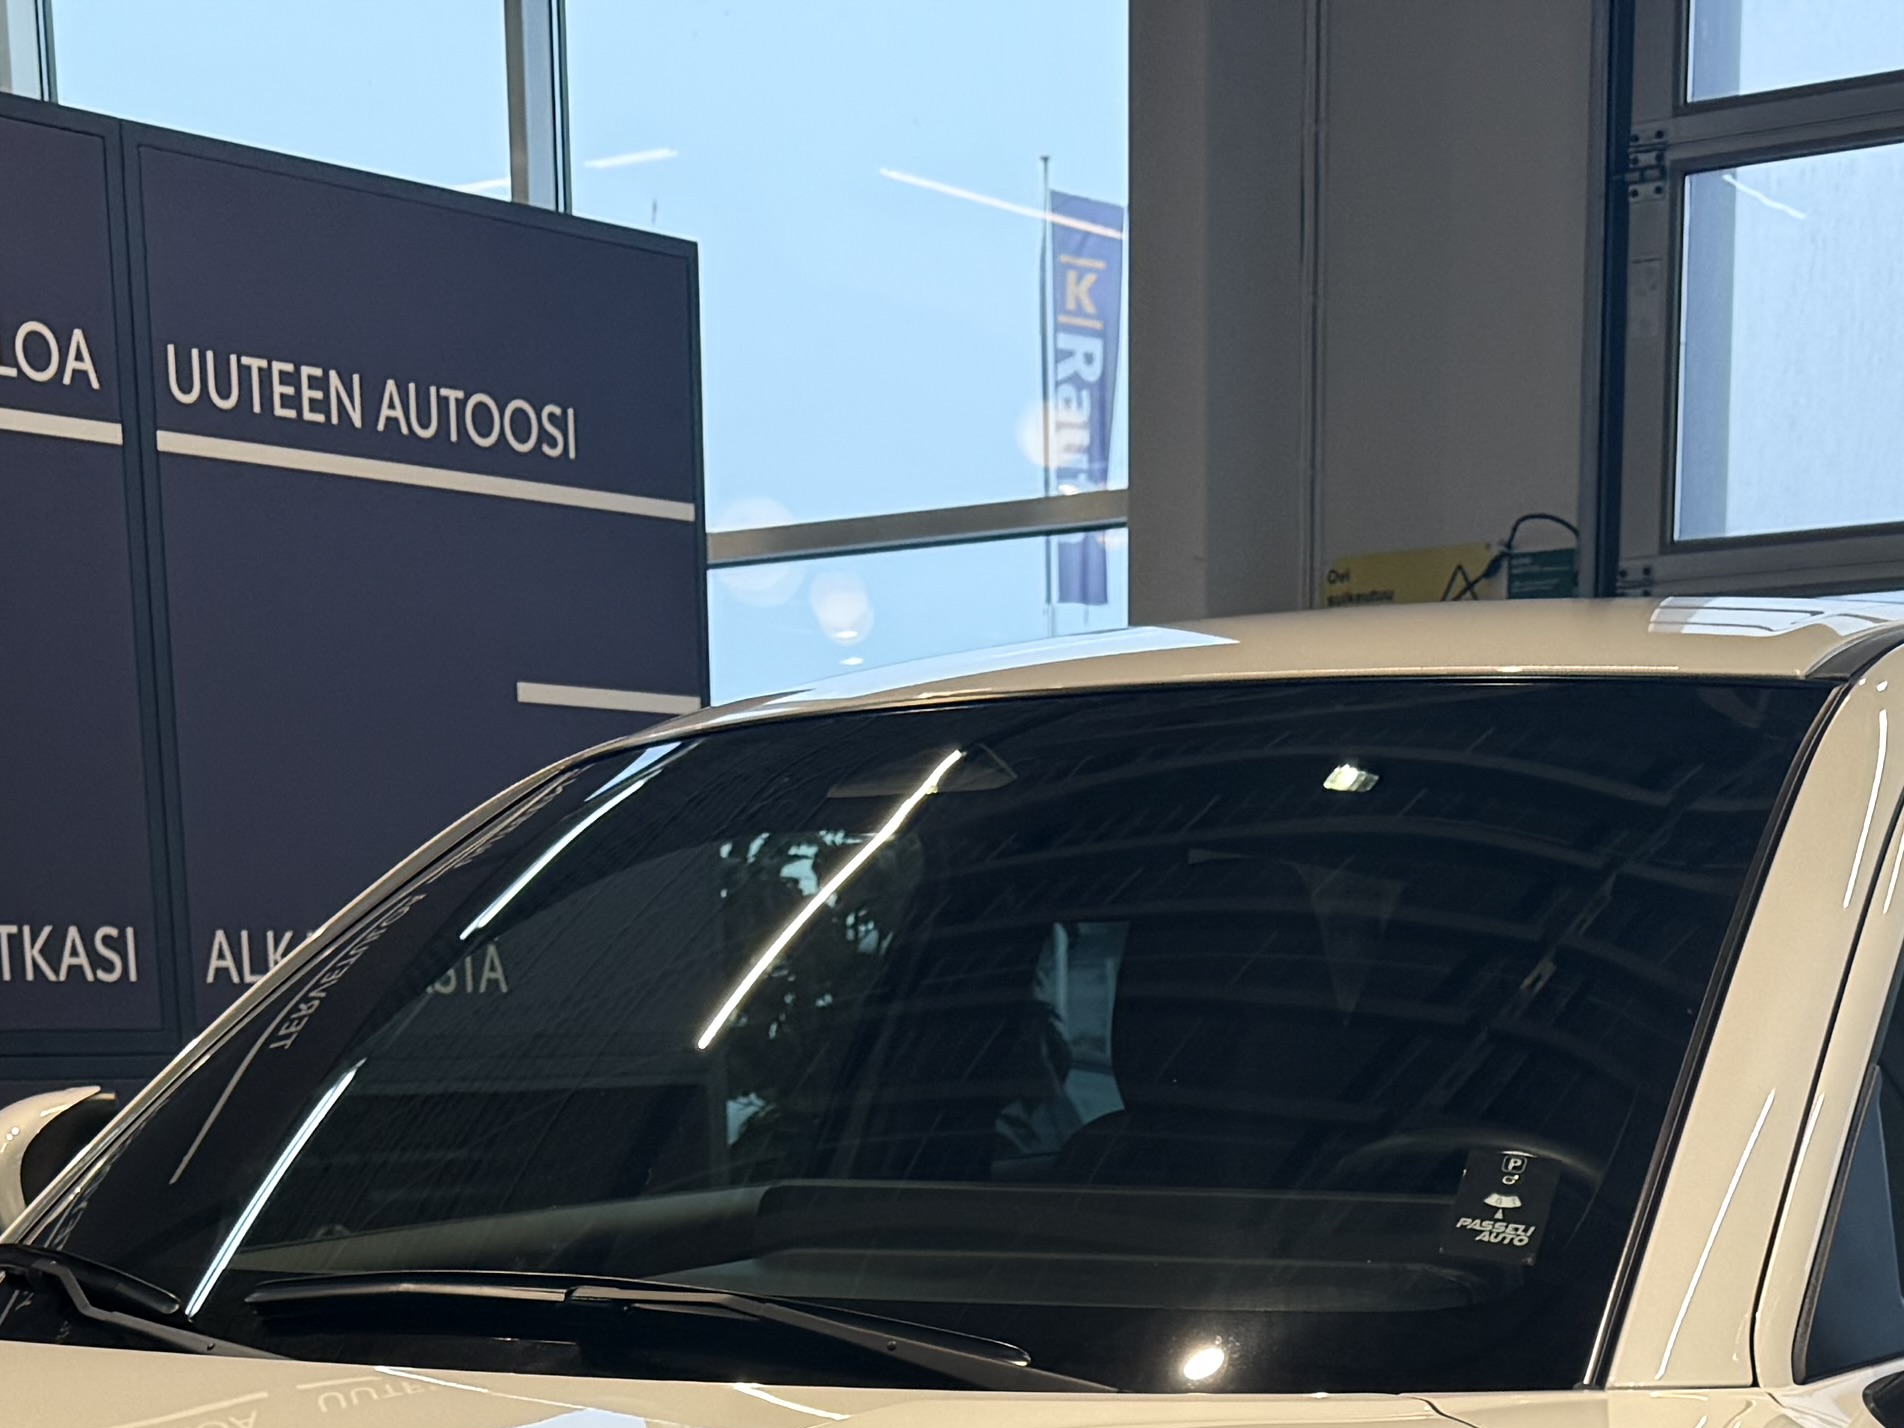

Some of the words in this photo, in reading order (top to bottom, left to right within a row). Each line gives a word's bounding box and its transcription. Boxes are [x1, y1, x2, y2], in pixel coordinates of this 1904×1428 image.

[163, 343, 363, 432] UUTEEN
[375, 379, 577, 461] AUTOOSI
[1456, 1217, 1536, 1237] PASSELI
[1476, 1230, 1529, 1246] AUTO
